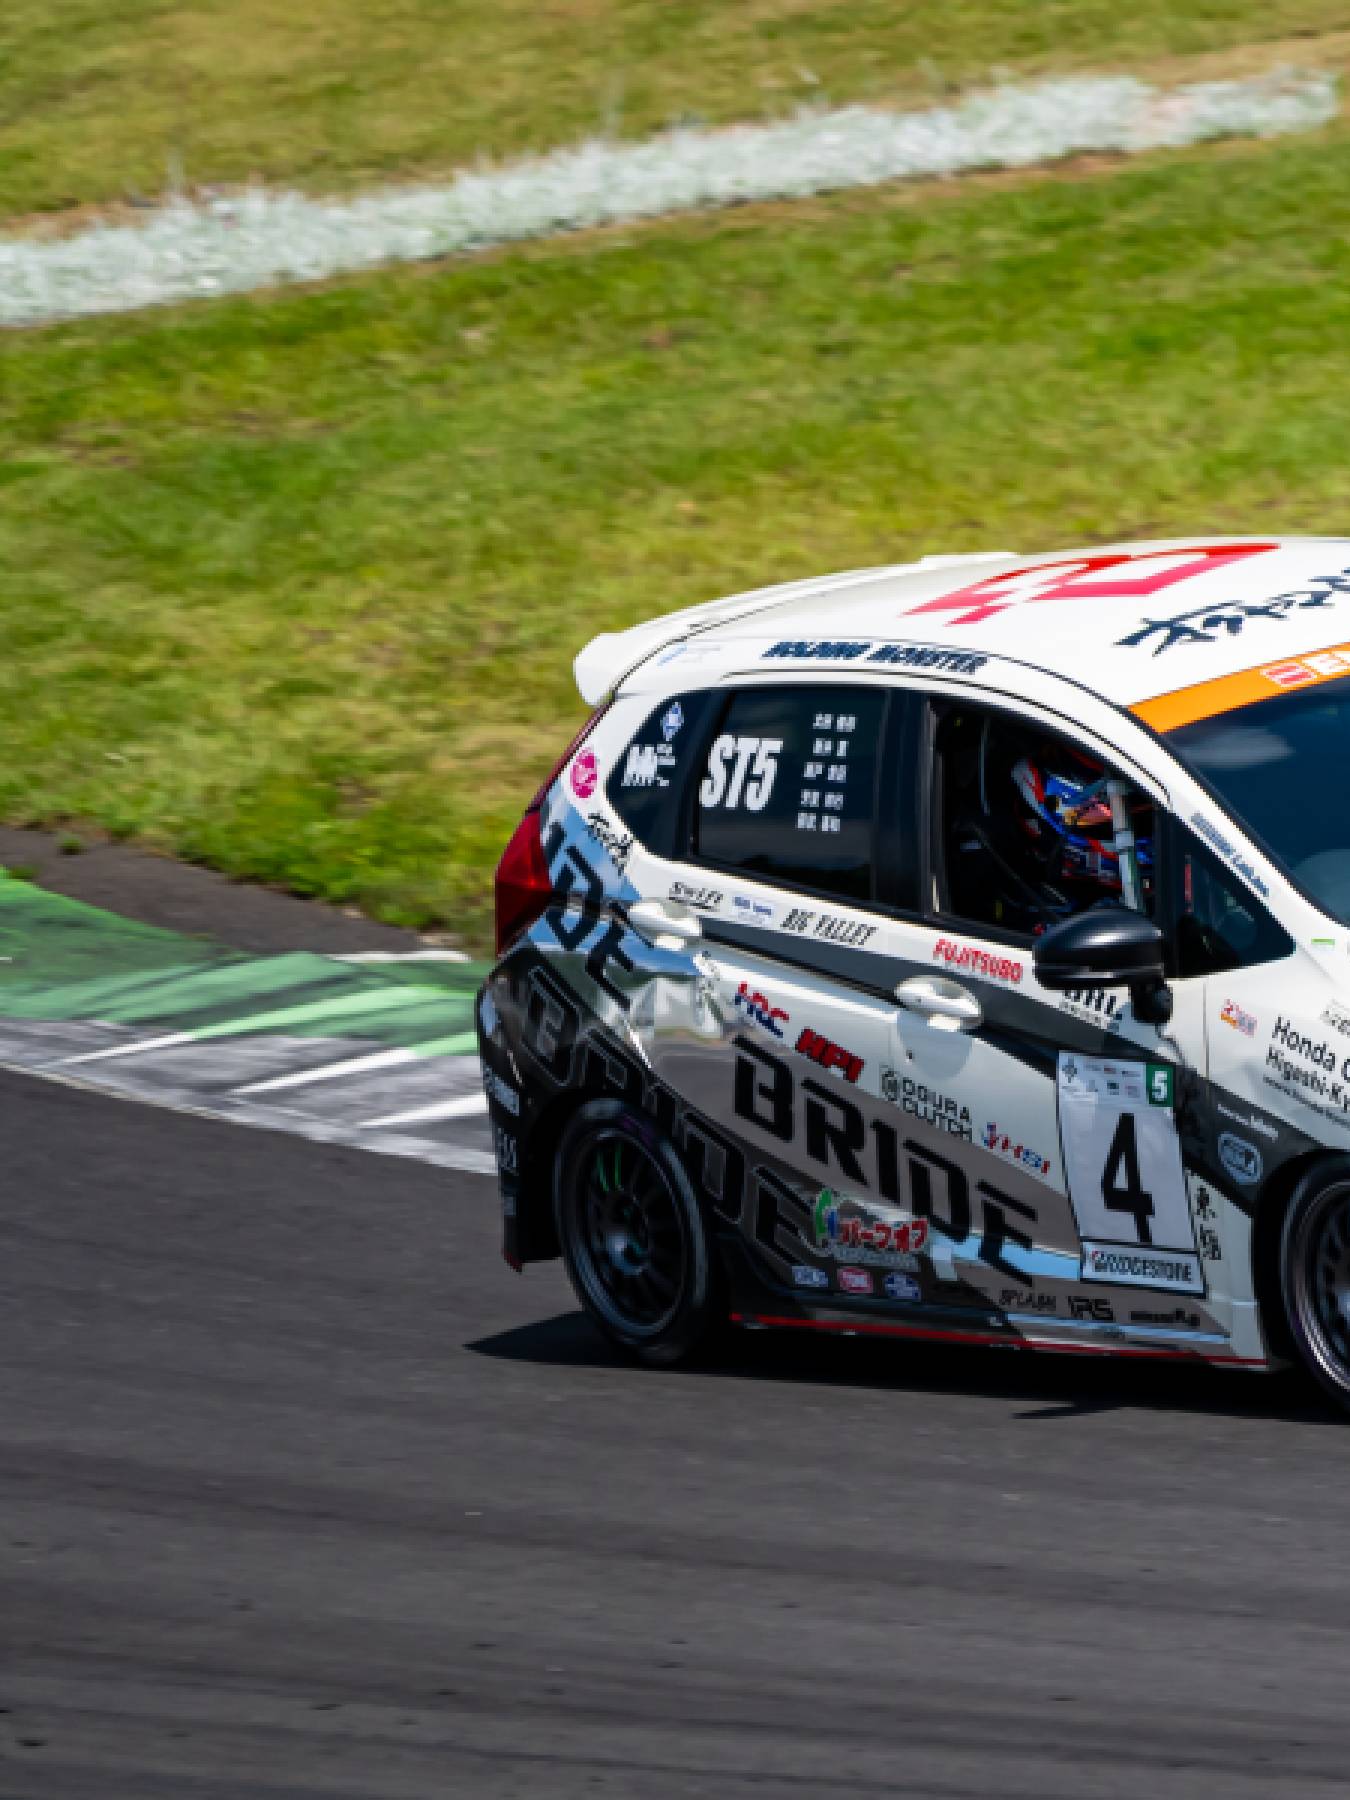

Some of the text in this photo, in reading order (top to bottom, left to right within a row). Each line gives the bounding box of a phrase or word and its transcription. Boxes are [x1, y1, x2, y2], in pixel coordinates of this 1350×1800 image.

[700, 734, 784, 811] ST5
[781, 907, 812, 931] BIG
[813, 914, 879, 946] VALLEY
[933, 938, 1024, 984] FUJITSUBO
[735, 981, 791, 1038] HRC
[795, 1027, 865, 1084] HPI
[1272, 1015, 1336, 1072] Honda
[901, 1077, 973, 1124] OGURA
[1151, 1069, 1169, 1102] 5
[732, 1034, 1039, 1289] BRIDE
[1101, 1111, 1156, 1244] 4
[1091, 1253, 1194, 1285] BRIDGESTONE
